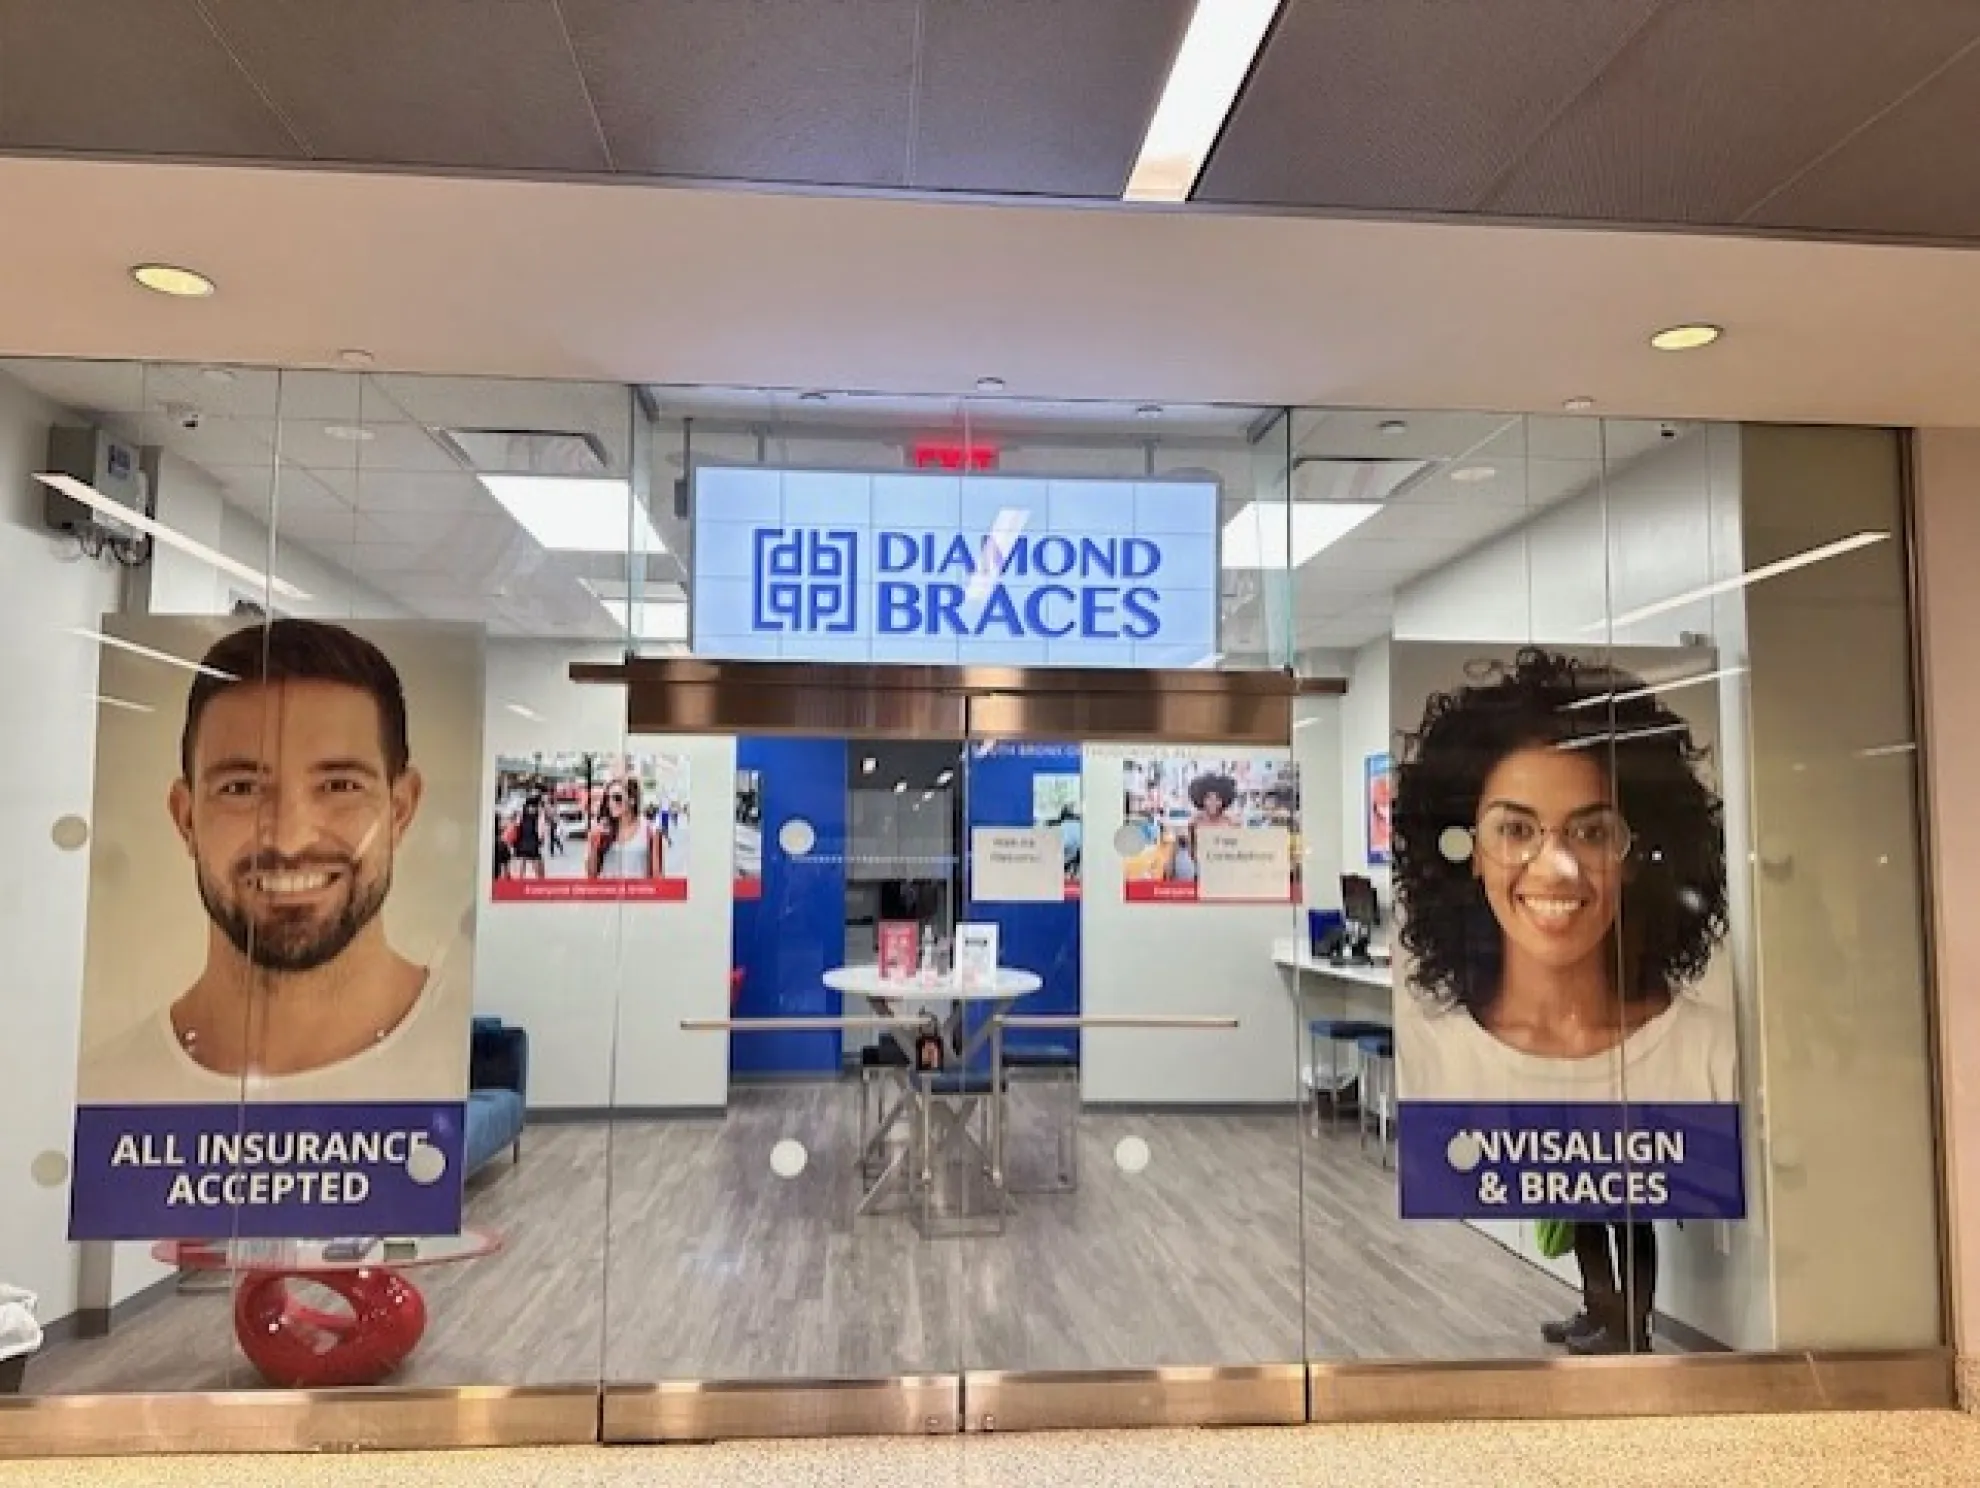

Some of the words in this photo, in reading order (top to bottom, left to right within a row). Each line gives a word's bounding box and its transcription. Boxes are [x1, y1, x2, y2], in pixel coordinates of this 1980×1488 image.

[878, 531, 1161, 577] DIAMOND
[878, 581, 1161, 639] BRACES
[110, 1134, 186, 1167] ALL
[1459, 1129, 1685, 1164] NVISALIGN
[166, 1171, 369, 1206] ACCEPTED
[1478, 1171, 1508, 1205] &
[1519, 1171, 1669, 1205] BRACES
